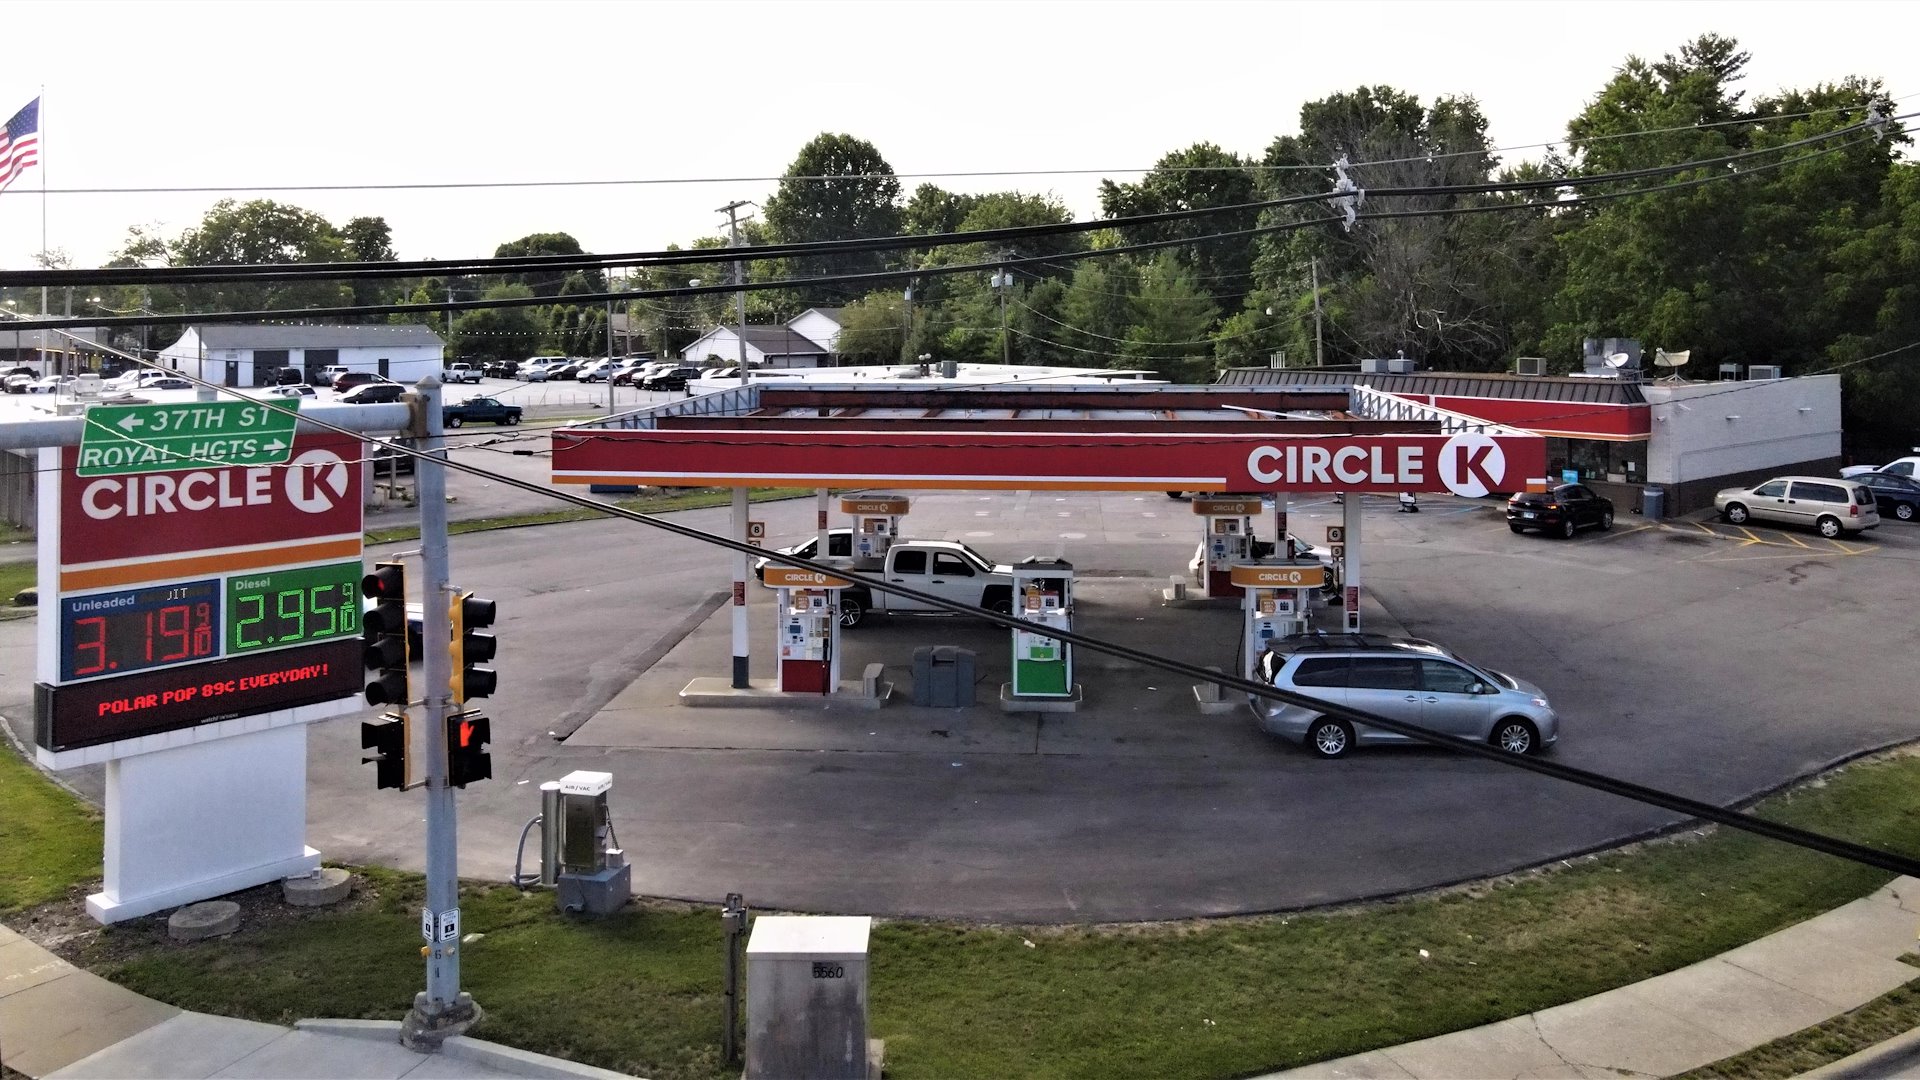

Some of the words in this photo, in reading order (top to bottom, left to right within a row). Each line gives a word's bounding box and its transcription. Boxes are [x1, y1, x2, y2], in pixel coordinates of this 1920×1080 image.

[150, 408, 225, 431] 37TH
[238, 406, 272, 427] ST
[82, 444, 177, 468] ROYAL
[190, 439, 258, 462] HGTS
[1247, 445, 1424, 484] CIRCLE
[81, 467, 272, 520] CIRCLE
[754, 526, 760, 534] 8
[1332, 530, 1338, 538] 6
[235, 577, 271, 591] Diesel
[785, 573, 813, 581] CIRCLE
[814, 572, 826, 583] K
[1258, 573, 1288, 581] CIRCLE
[1289, 571, 1301, 583] K
[72, 595, 135, 612] Unleaded
[237, 584, 336, 648] 2.95
[74, 605, 190, 675] 3.19
[98, 694, 158, 717] POLAR
[162, 687, 197, 705] POP
[240, 663, 329, 690] EVERYDAY!
[813, 966, 843, 979] 5560
